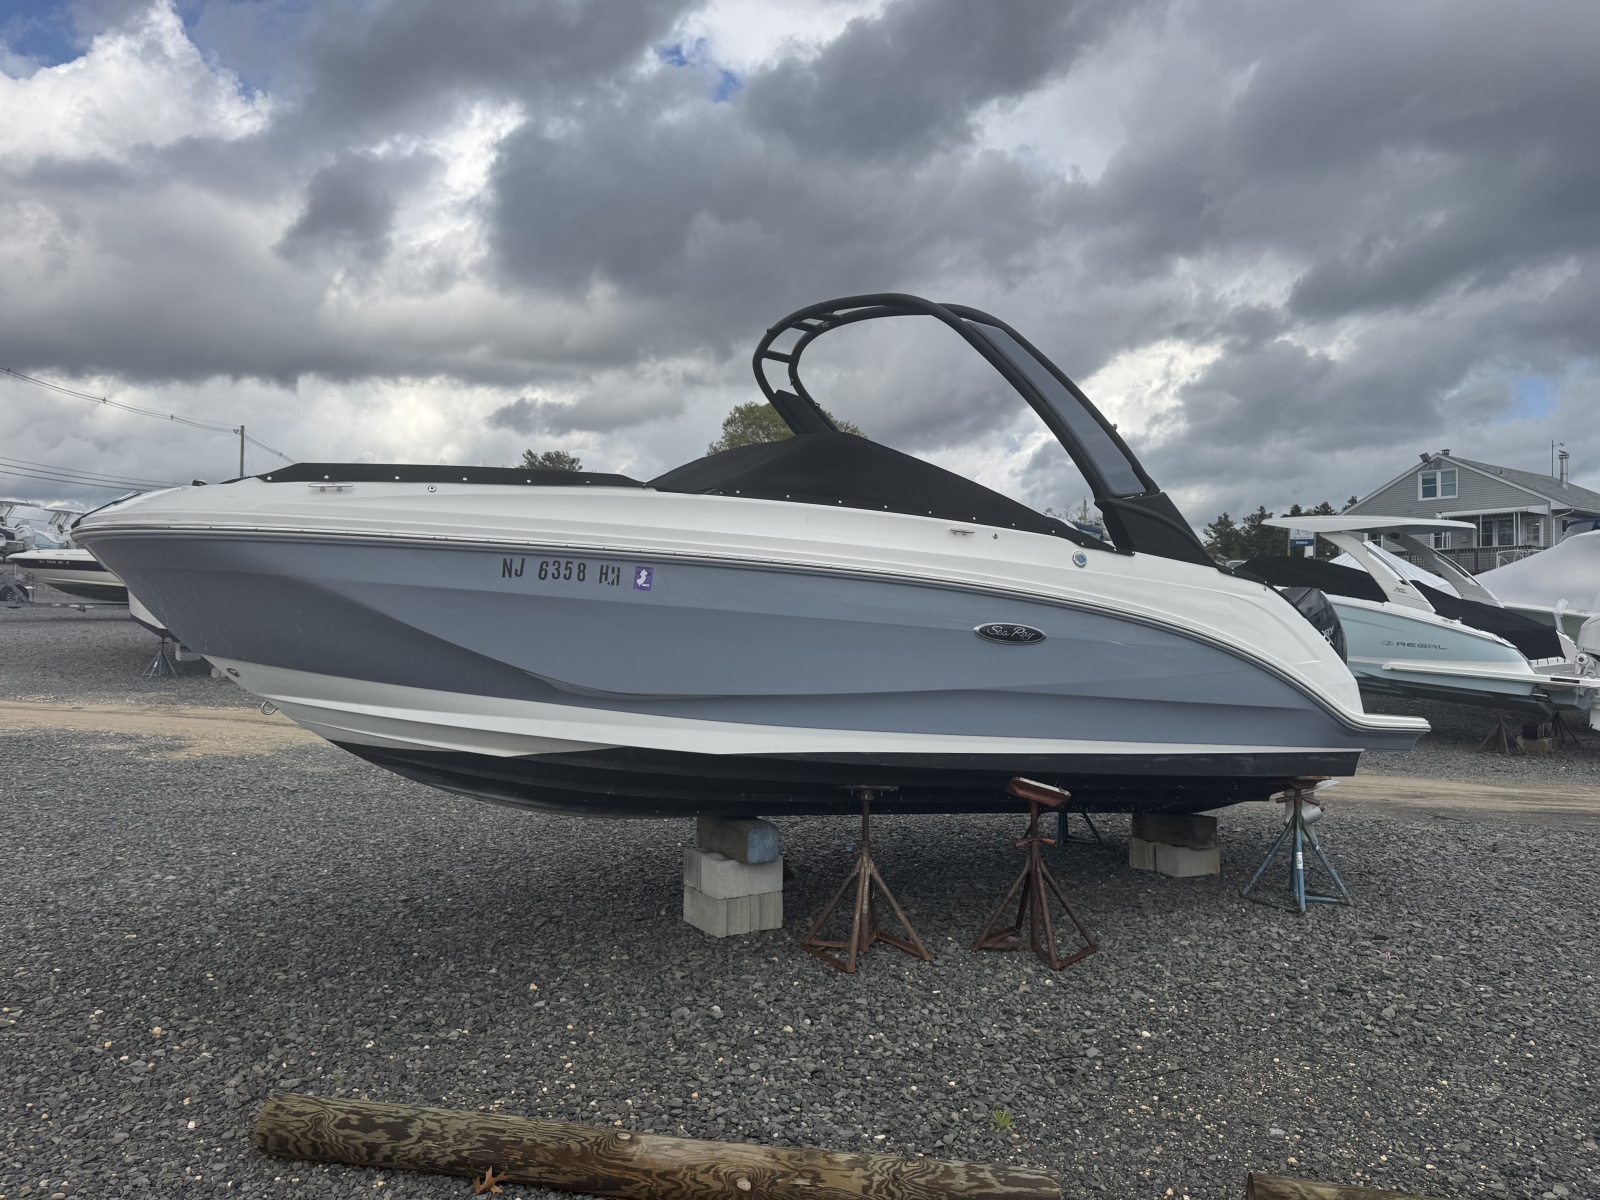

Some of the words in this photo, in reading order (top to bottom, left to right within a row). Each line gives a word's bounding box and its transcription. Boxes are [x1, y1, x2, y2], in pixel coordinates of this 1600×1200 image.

[501, 558, 526, 578] NJ
[538, 560, 586, 582] 6358
[986, 626, 1010, 636] Sea
[1011, 627, 1035, 640] Ray
[1396, 641, 1448, 650] REGAL
